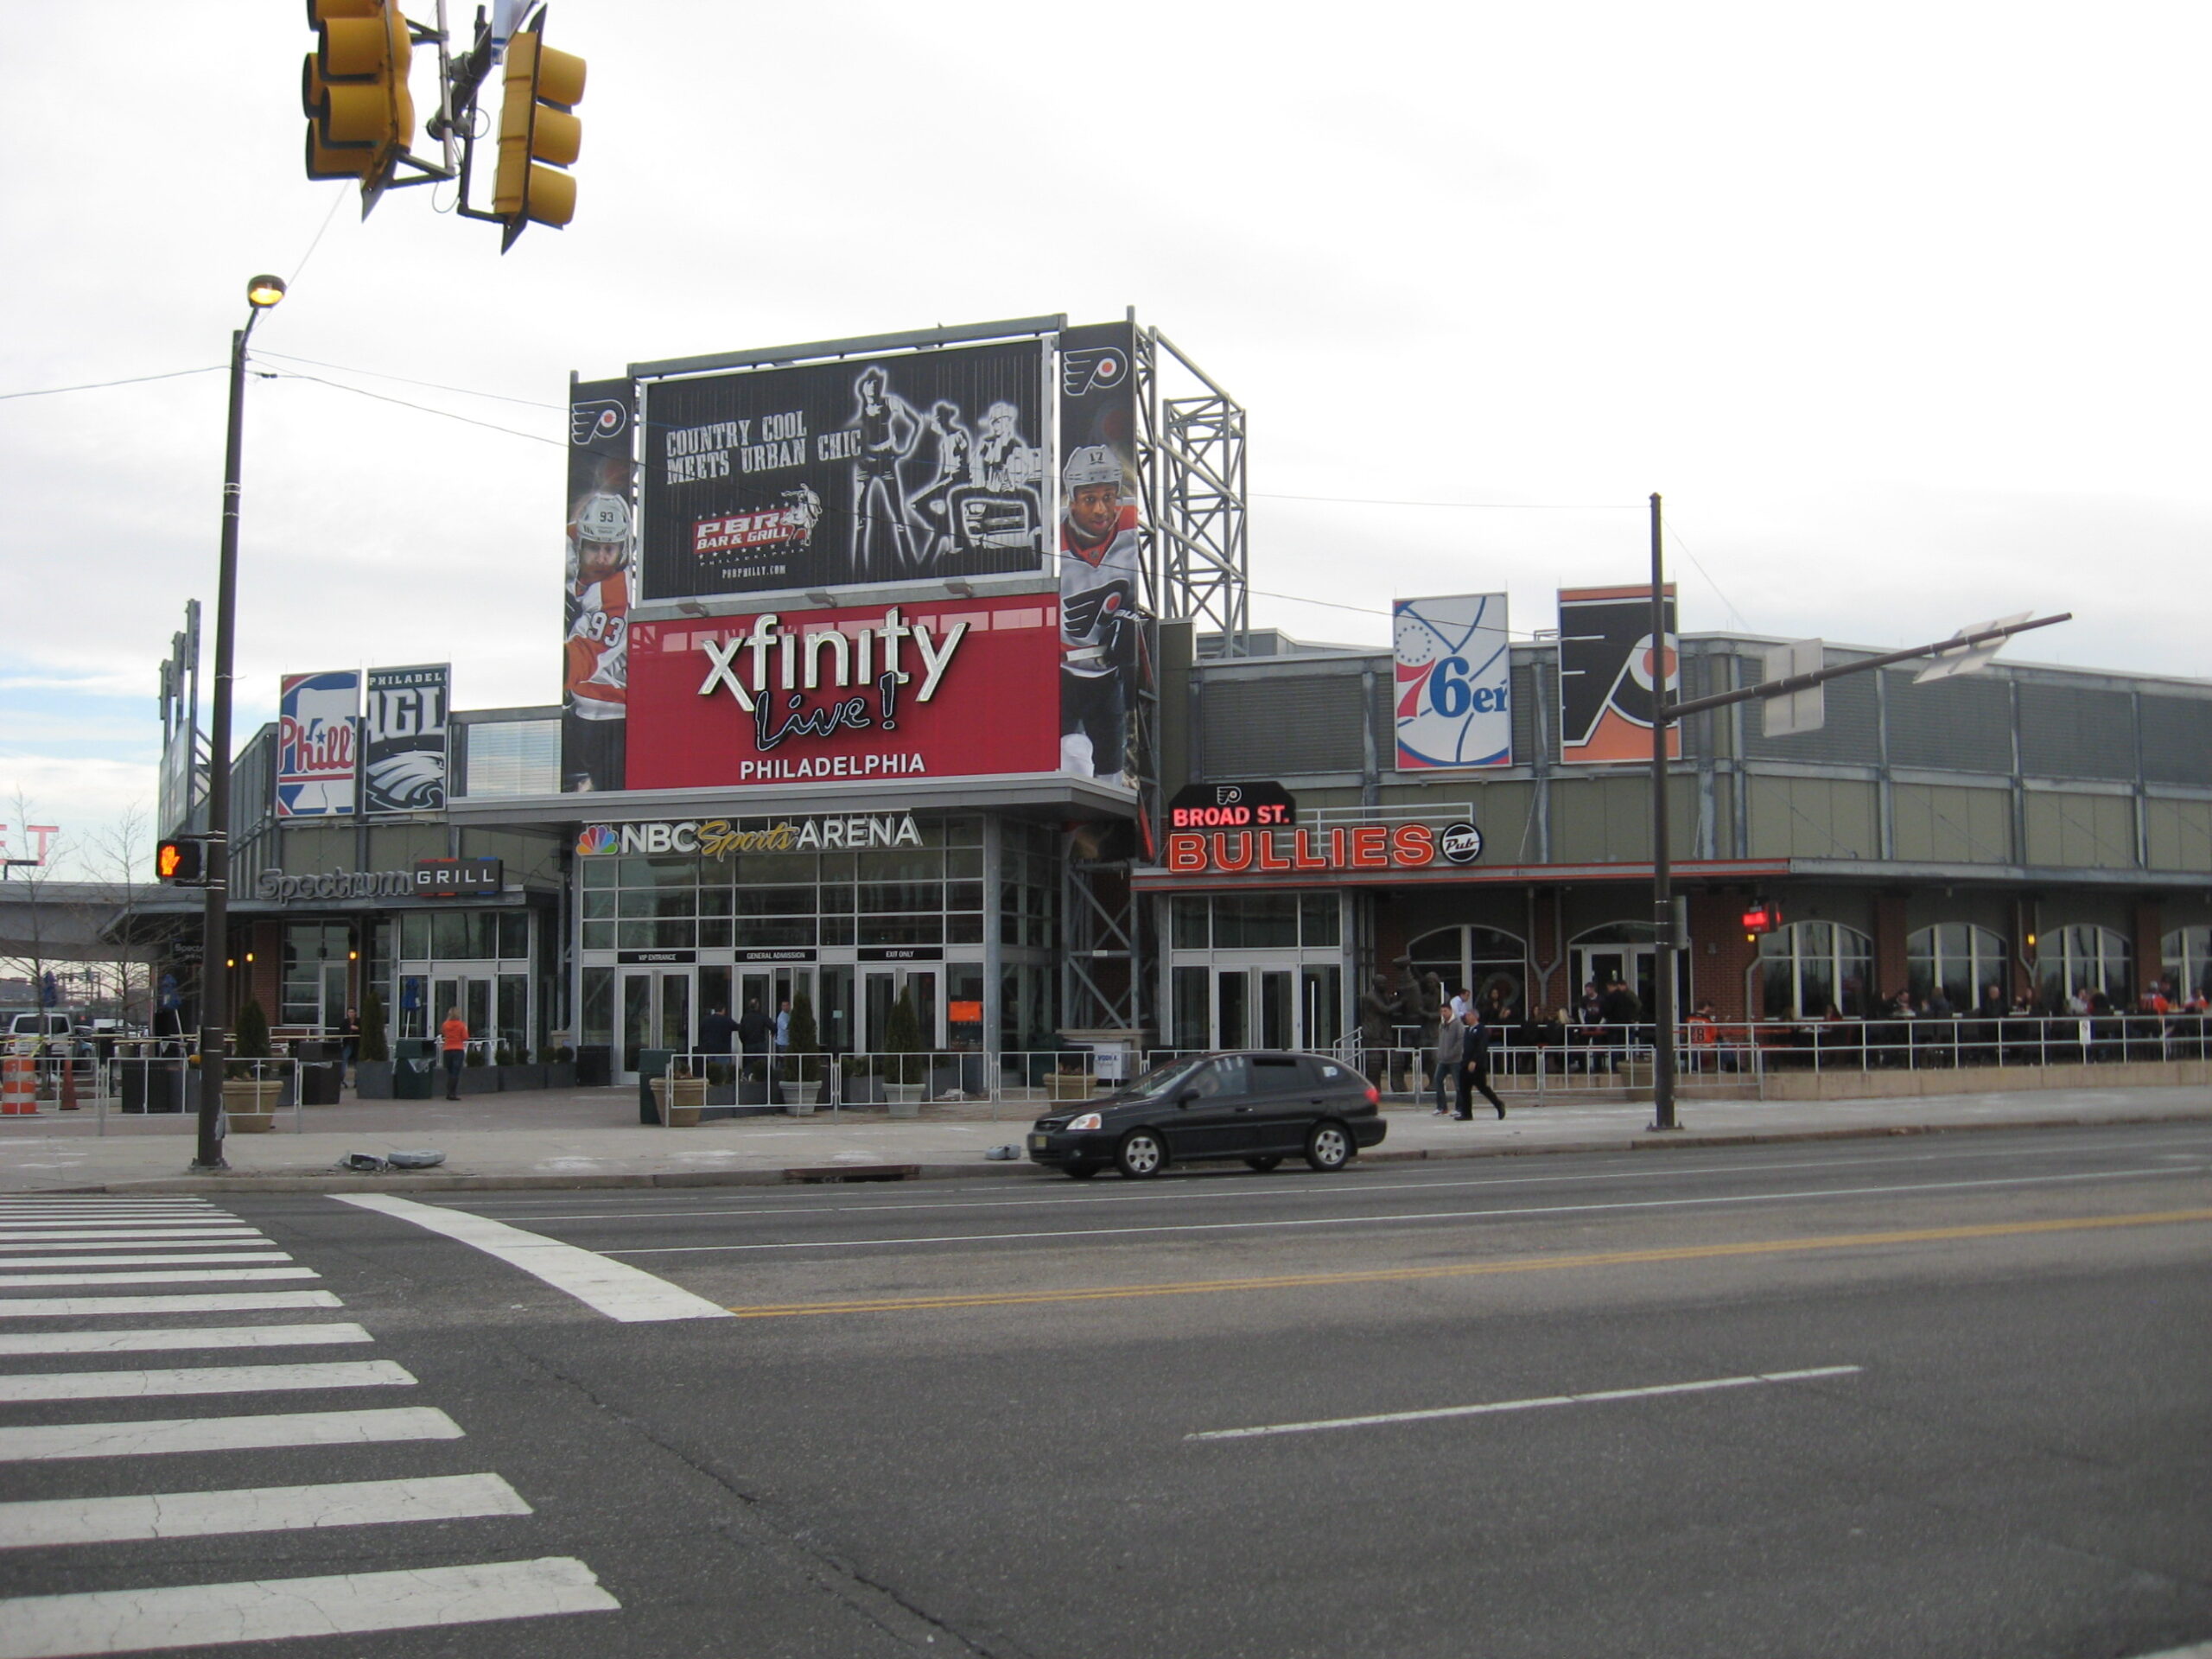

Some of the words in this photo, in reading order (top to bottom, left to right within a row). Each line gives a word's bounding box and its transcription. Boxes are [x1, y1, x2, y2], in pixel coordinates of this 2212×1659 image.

[665, 419, 751, 457] COUNTRY
[762, 410, 807, 442] COOL
[666, 450, 730, 485] MEETS
[741, 438, 806, 474] URBAN
[817, 429, 861, 461] CHIC
[600, 512, 613, 523] 93
[697, 512, 780, 538] PBR
[696, 536, 728, 550] BAR
[731, 533, 742, 544] &
[747, 527, 789, 543] GRILL
[587, 611, 626, 647] 93
[698, 607, 970, 712] xfinity
[755, 671, 896, 751] Live!
[741, 753, 926, 779] PHILADELPHIA
[1173, 806, 1250, 827] BROAD
[1256, 804, 1290, 824] ST.
[620, 823, 699, 855] NBC
[696, 819, 800, 862] Sports
[796, 817, 924, 849] ARENA
[1168, 823, 1435, 872] BULLIES
[1445, 835, 1478, 852] Pub
[259, 867, 415, 906] Spectrum
[416, 868, 495, 884] GRILL
